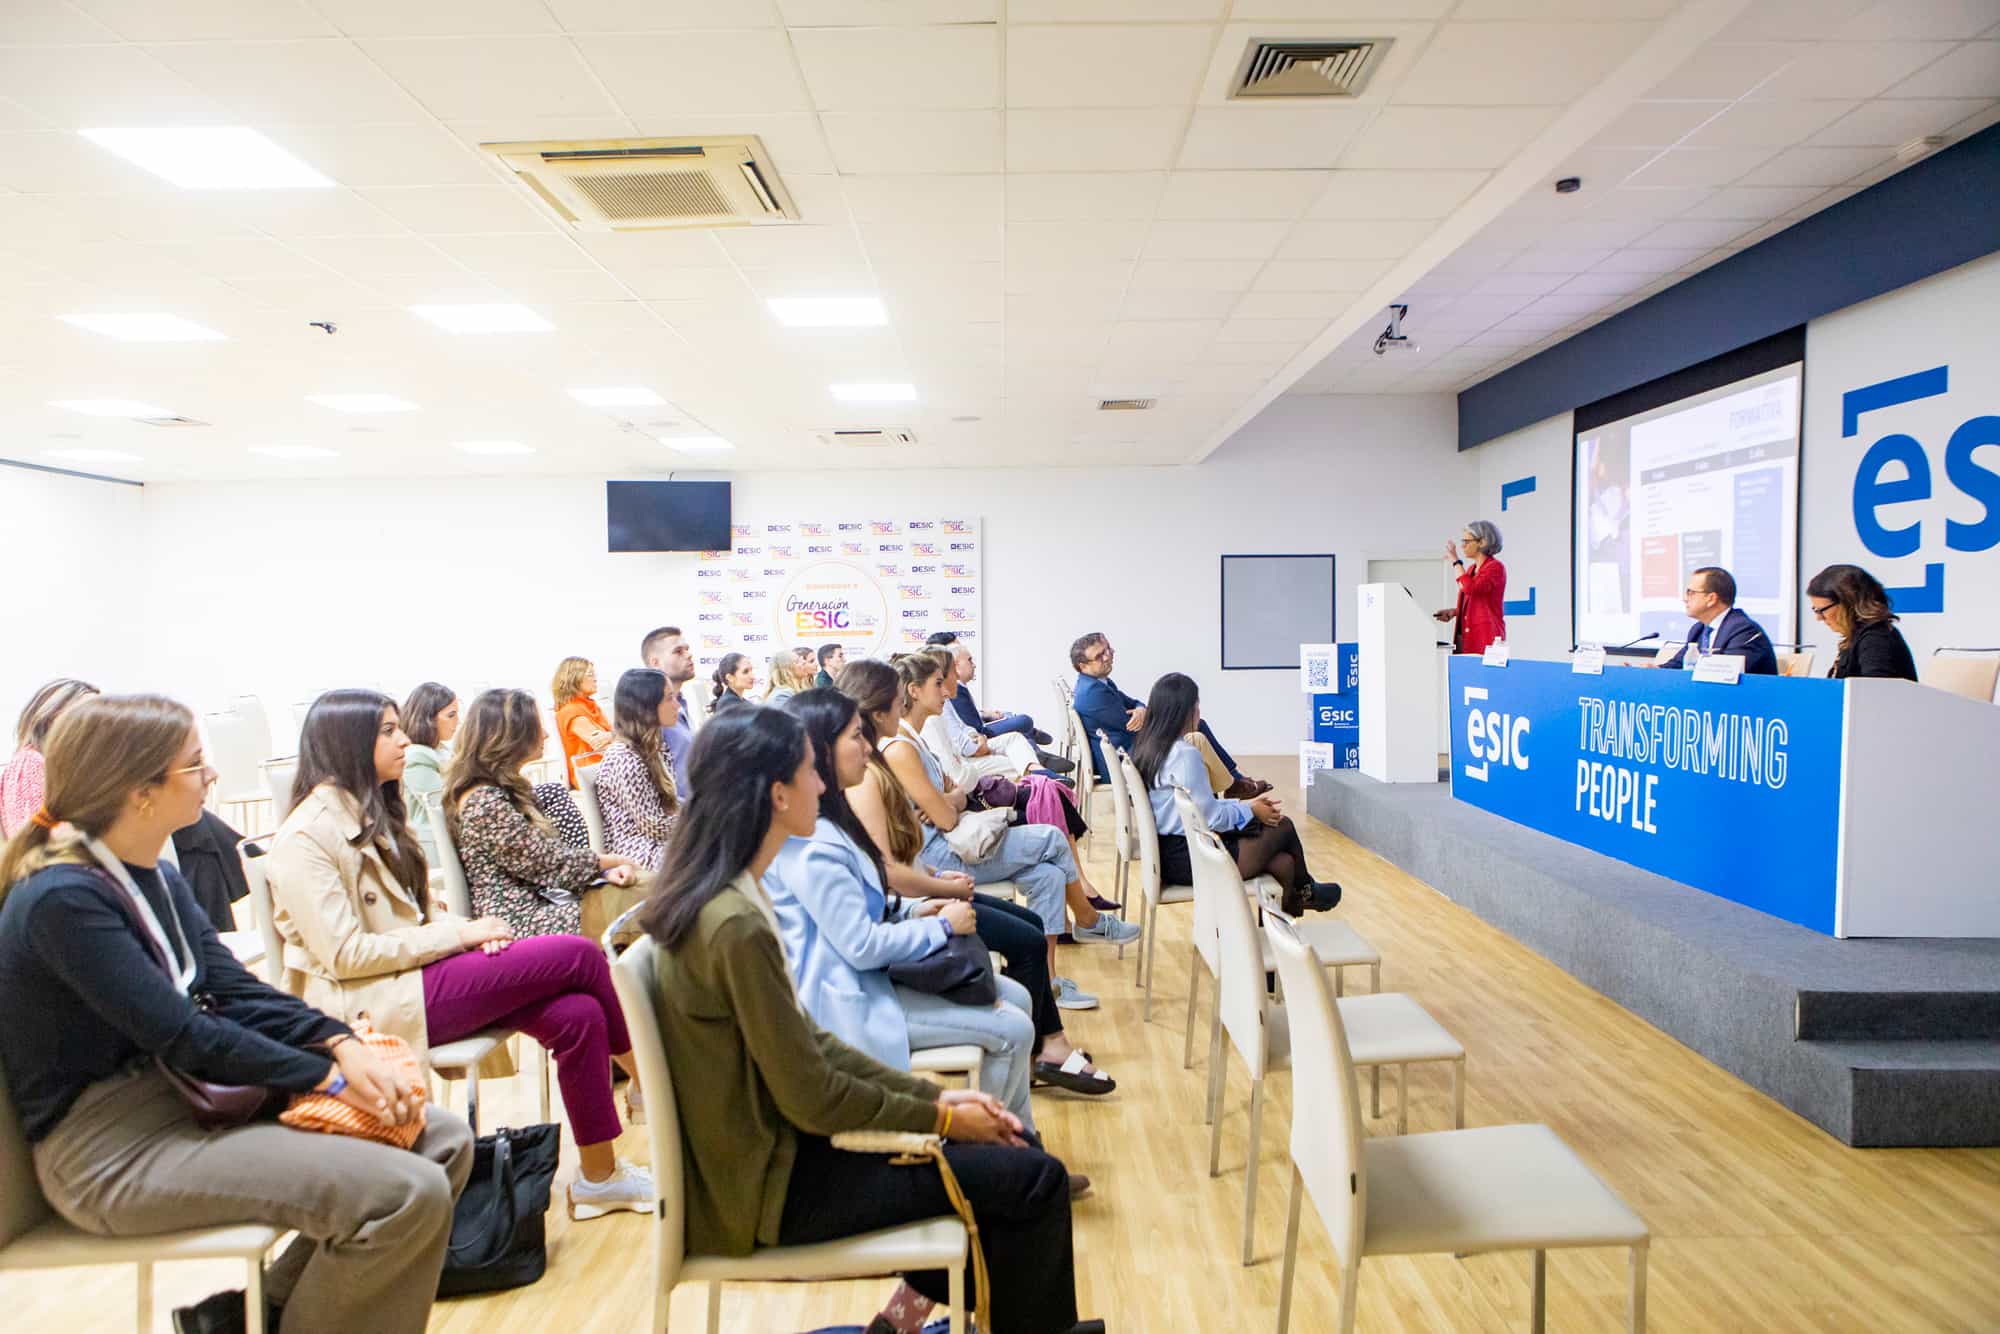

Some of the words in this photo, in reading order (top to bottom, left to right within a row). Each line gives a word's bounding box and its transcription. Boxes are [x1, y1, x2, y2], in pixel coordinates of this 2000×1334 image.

[796, 611, 849, 629] ESIC
[1321, 710, 1354, 721] esic
[1467, 708, 1530, 770] esic
[1578, 697, 1788, 789] TRANSFORMING
[1576, 759, 1659, 834] PEOPLE
